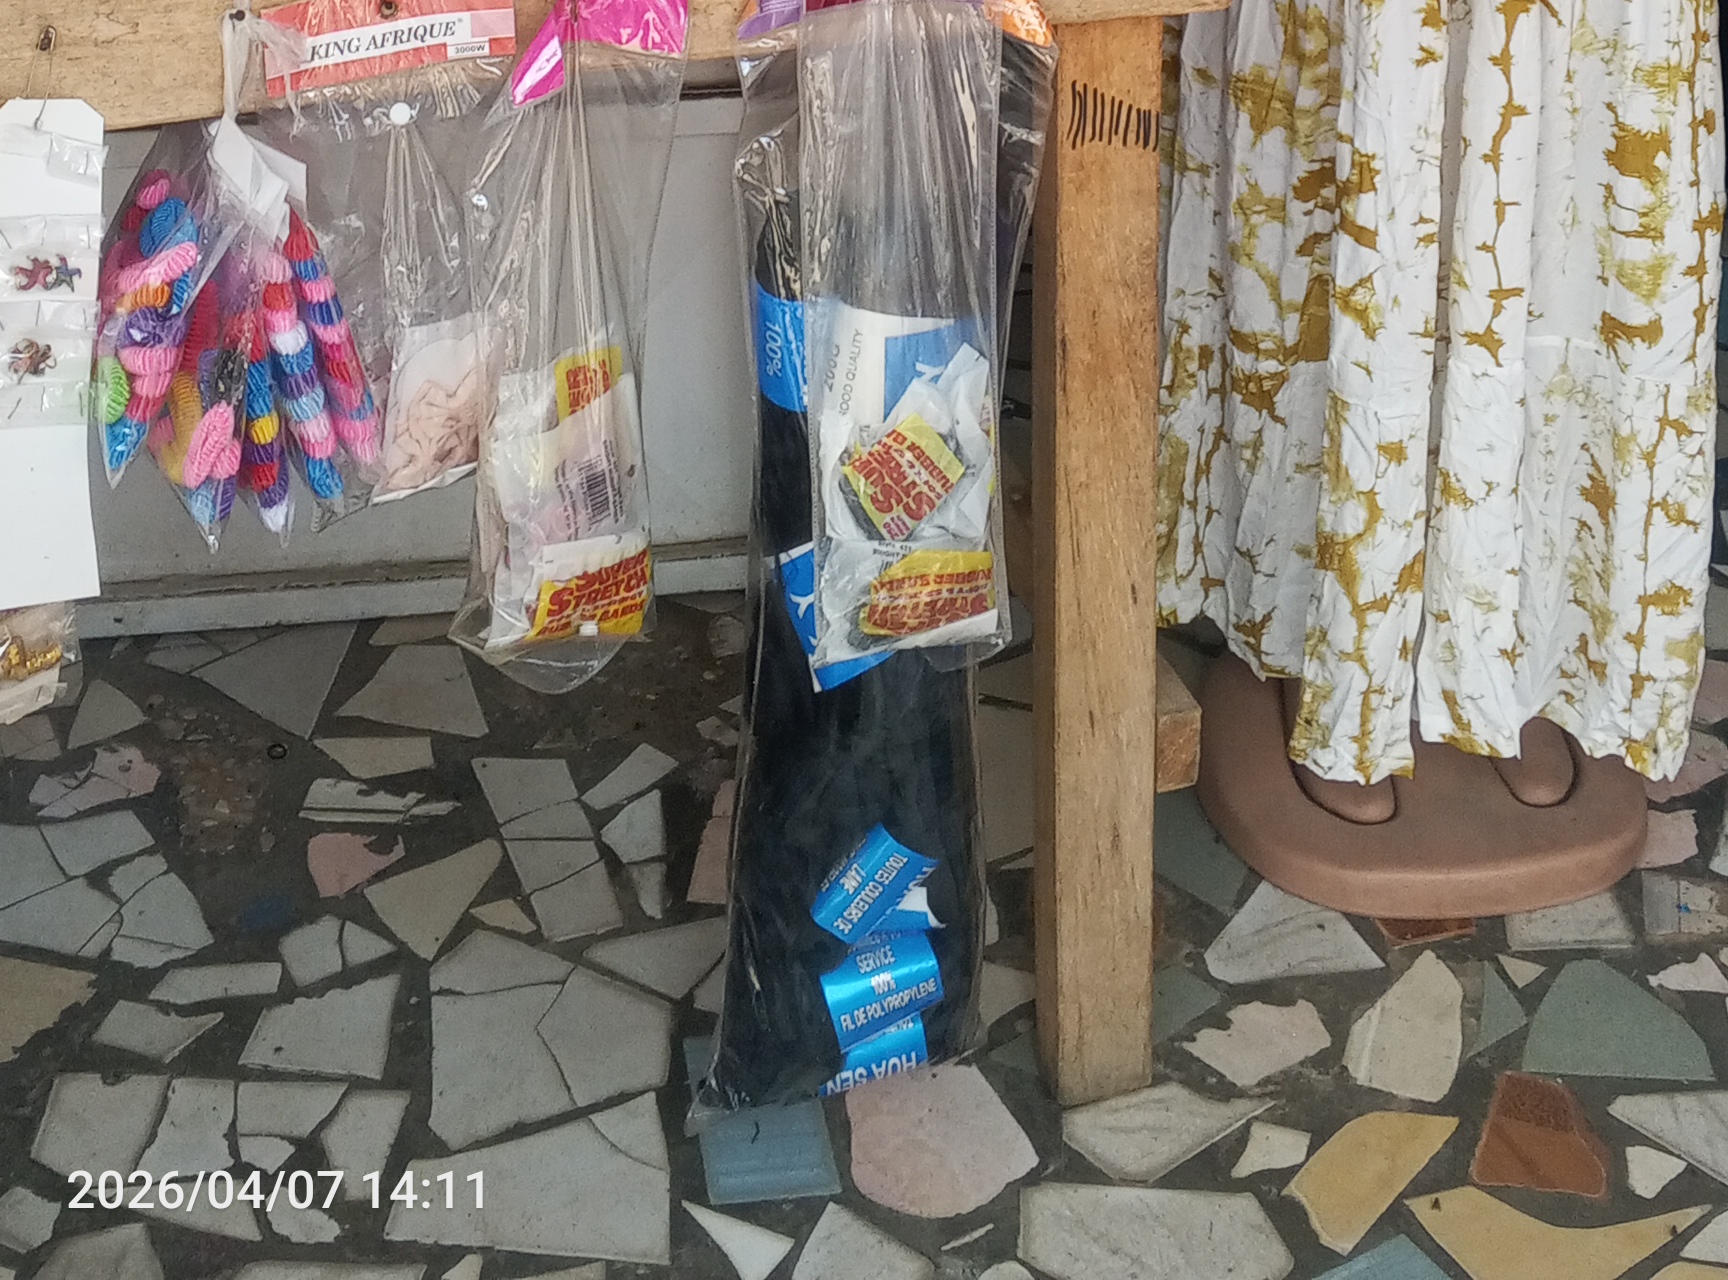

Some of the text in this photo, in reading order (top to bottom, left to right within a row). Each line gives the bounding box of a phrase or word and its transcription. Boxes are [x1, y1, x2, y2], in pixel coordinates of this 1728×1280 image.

[310, 20, 457, 62] KING AFRIQUE
[455, 43, 486, 55] 3000W
[766, 321, 782, 378] 100%
[846, 328, 863, 381] QUALITY
[547, 567, 648, 617] STRETCH
[875, 852, 909, 886] TOUTES
[856, 945, 896, 974] SERVICE
[840, 1014, 855, 1033] FIL
[853, 1008, 867, 1027] DE
[865, 977, 938, 1021] POLYPROPYLENE
[870, 972, 897, 996] 100%
[826, 1052, 917, 1096] HUA SEN
